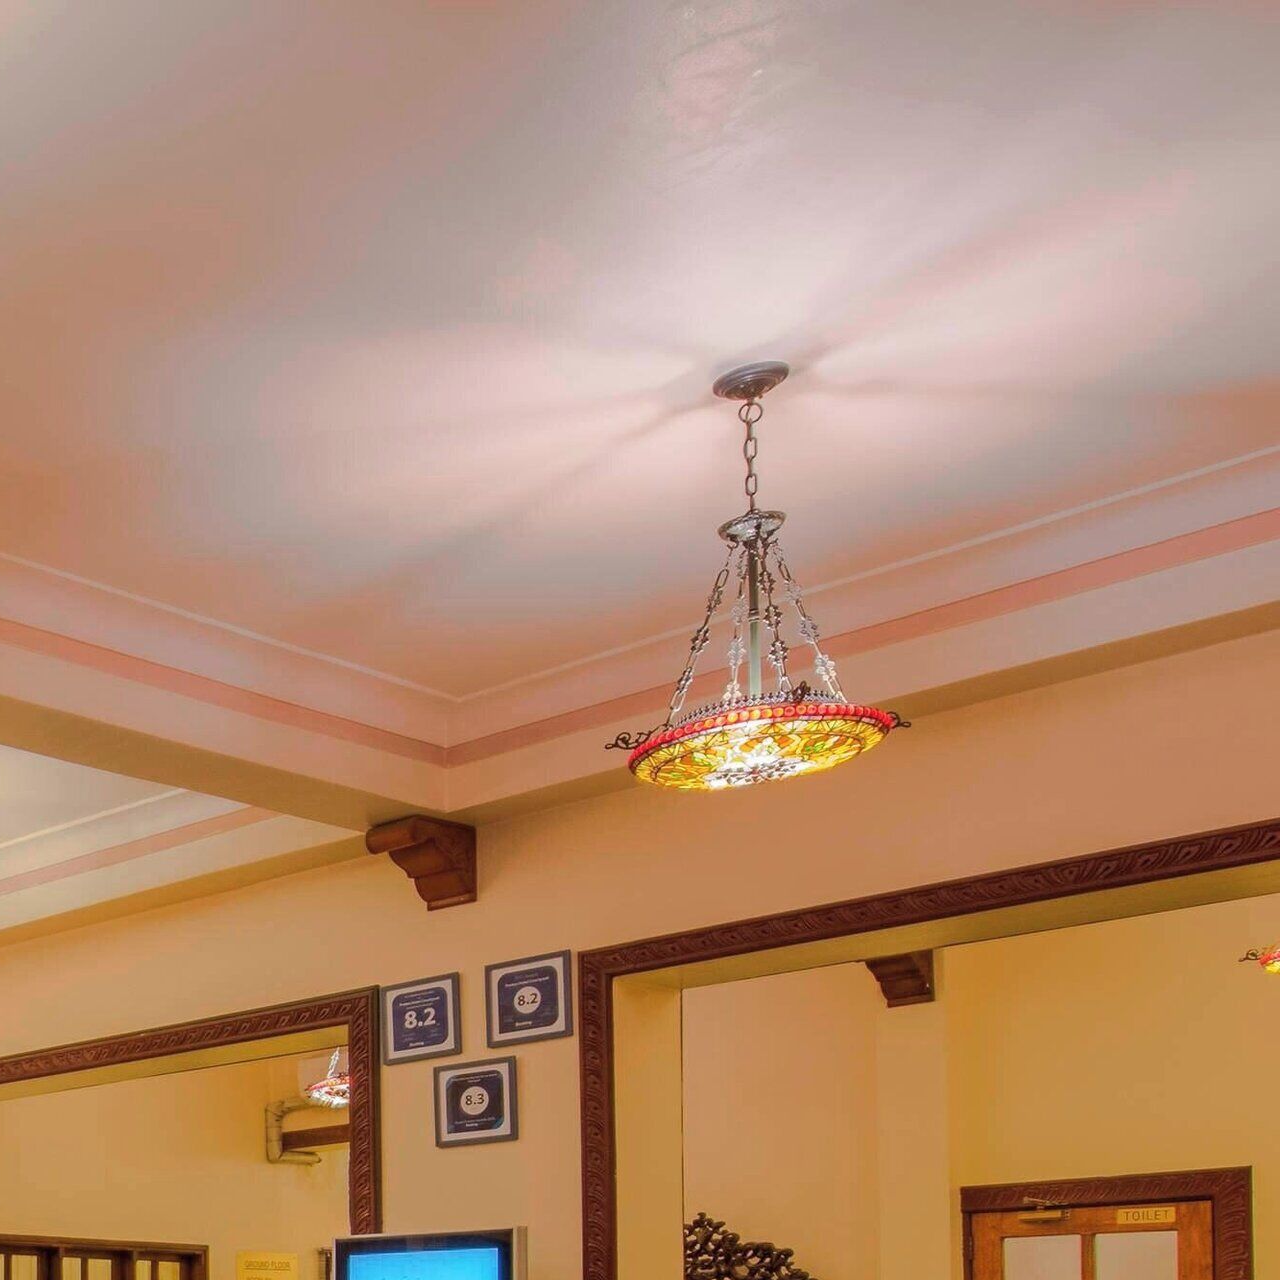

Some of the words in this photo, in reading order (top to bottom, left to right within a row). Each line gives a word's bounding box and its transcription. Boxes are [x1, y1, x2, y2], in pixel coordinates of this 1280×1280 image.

[518, 993, 538, 1006] 8.2
[404, 1007, 436, 1029] 8.2
[465, 1093, 485, 1105] 8.3
[1123, 1210, 1169, 1221] TOILET
